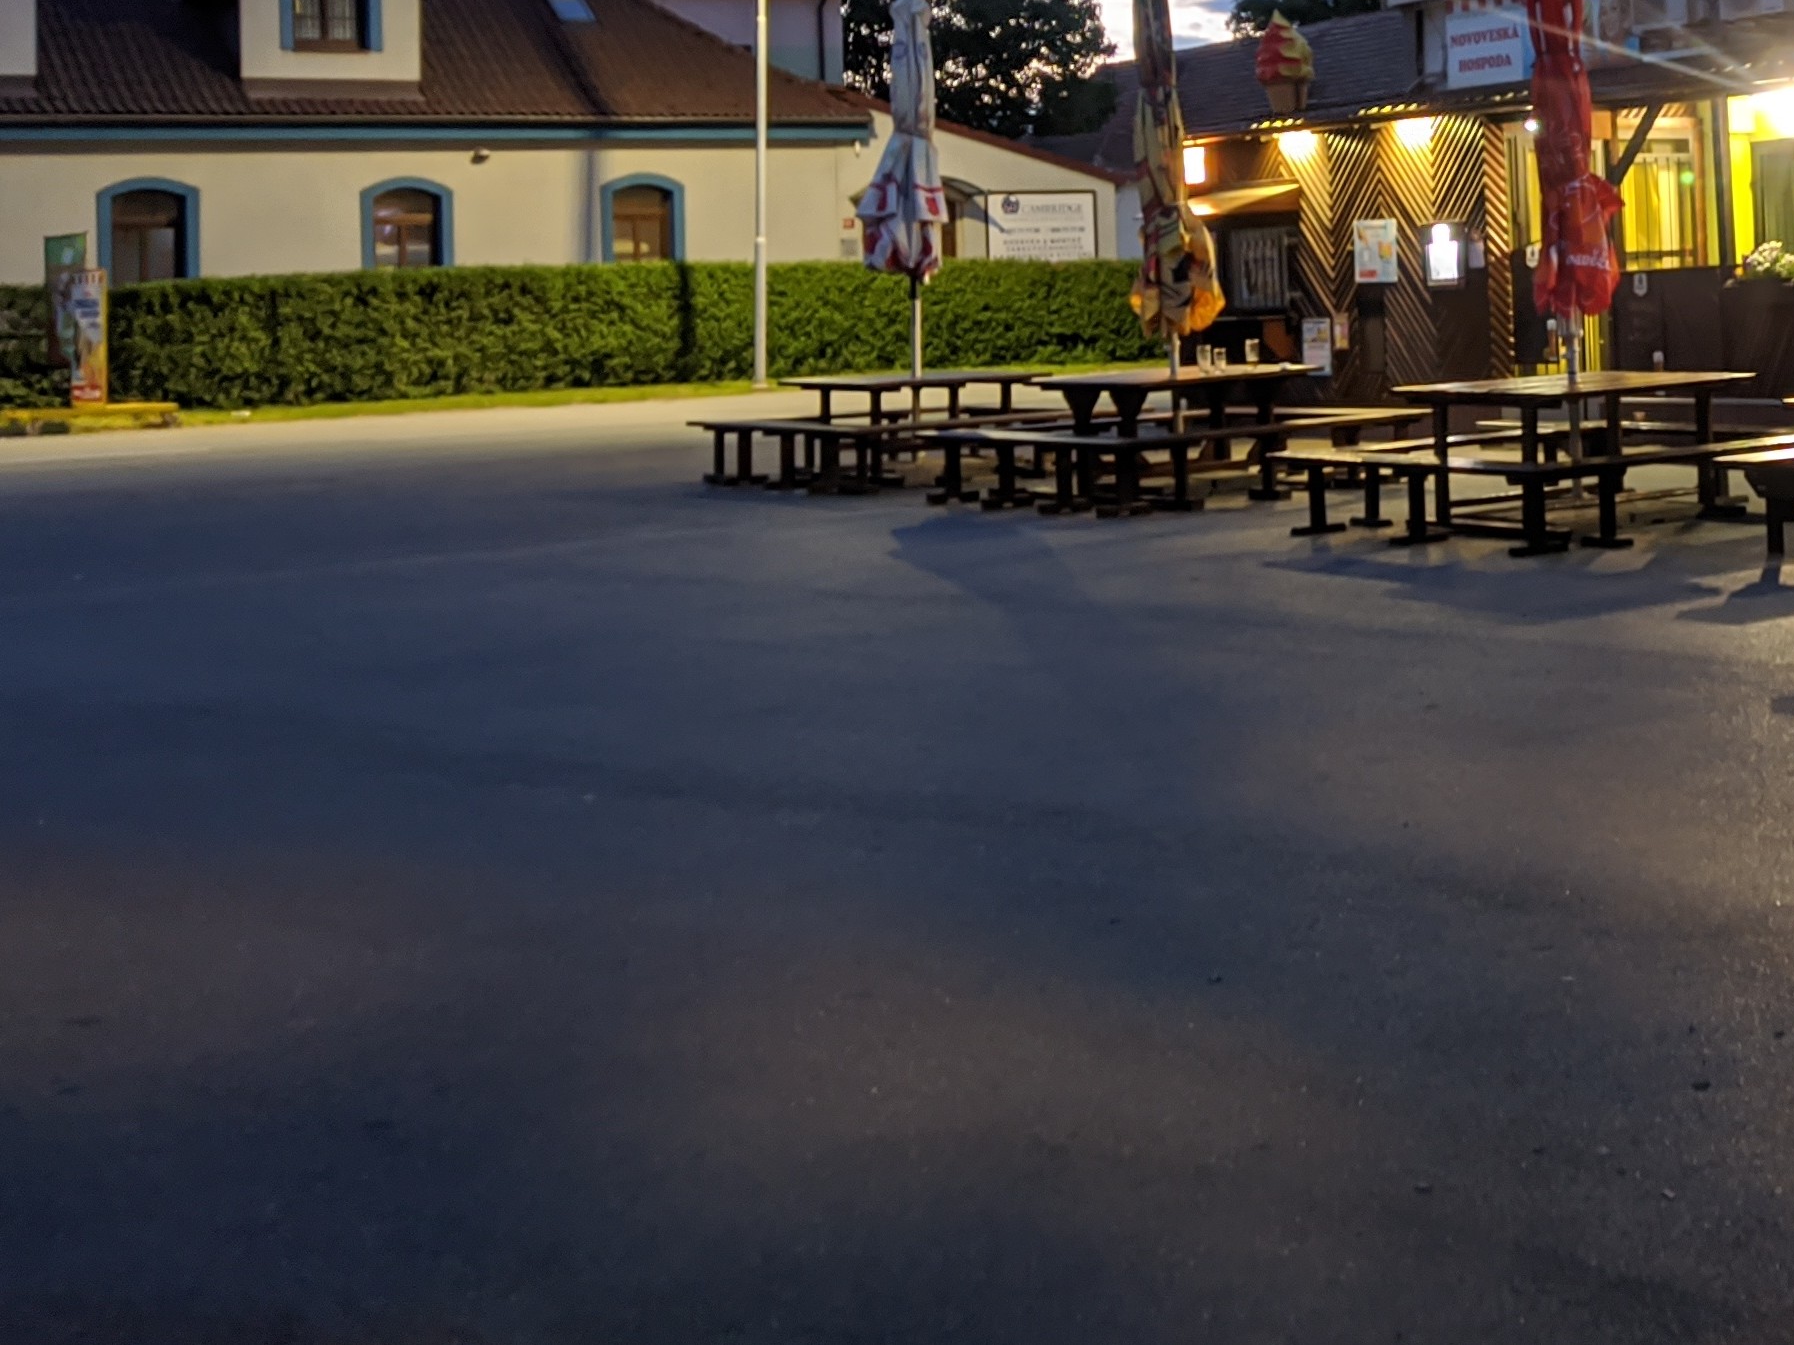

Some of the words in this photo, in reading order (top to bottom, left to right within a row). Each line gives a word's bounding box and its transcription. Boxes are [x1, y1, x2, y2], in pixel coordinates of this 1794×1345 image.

[1450, 22, 1519, 48] NOVOVESKÁ
[1459, 54, 1512, 73] HOSPODA
[1021, 203, 1082, 214] CAMBRIDGE
